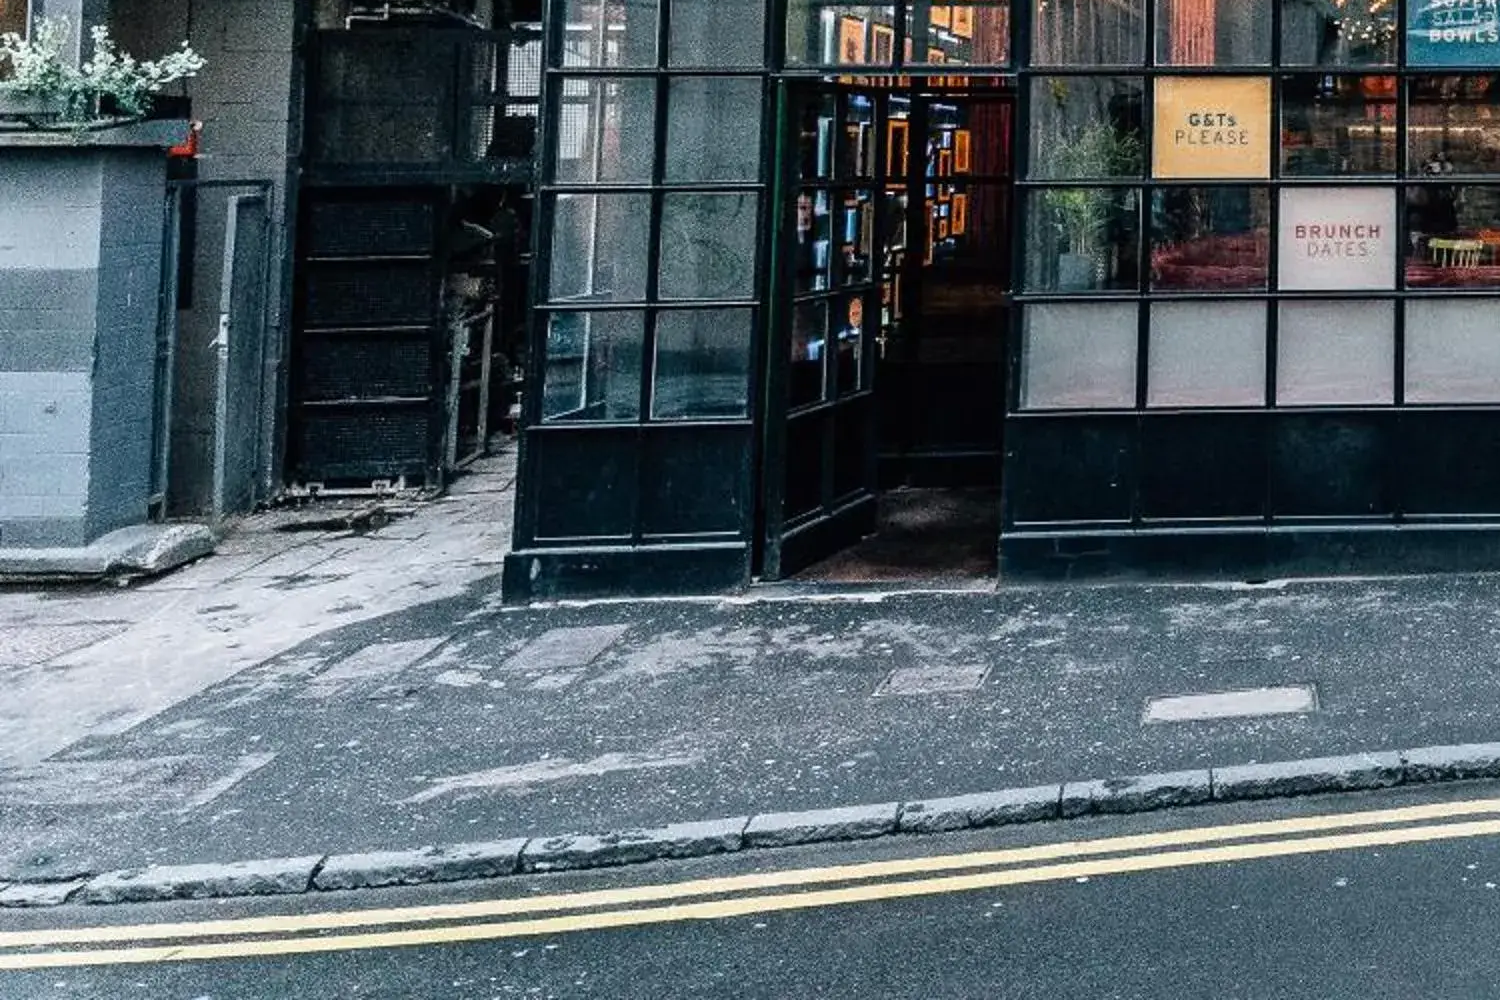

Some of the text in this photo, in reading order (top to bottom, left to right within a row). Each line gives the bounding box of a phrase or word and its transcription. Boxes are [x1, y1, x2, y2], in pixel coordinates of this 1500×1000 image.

[1429, 28, 1499, 43] BOWLS
[1175, 129, 1249, 145] PLEASE
[1295, 224, 1381, 239] BRUNCH
[1307, 241, 1369, 257] DATES
